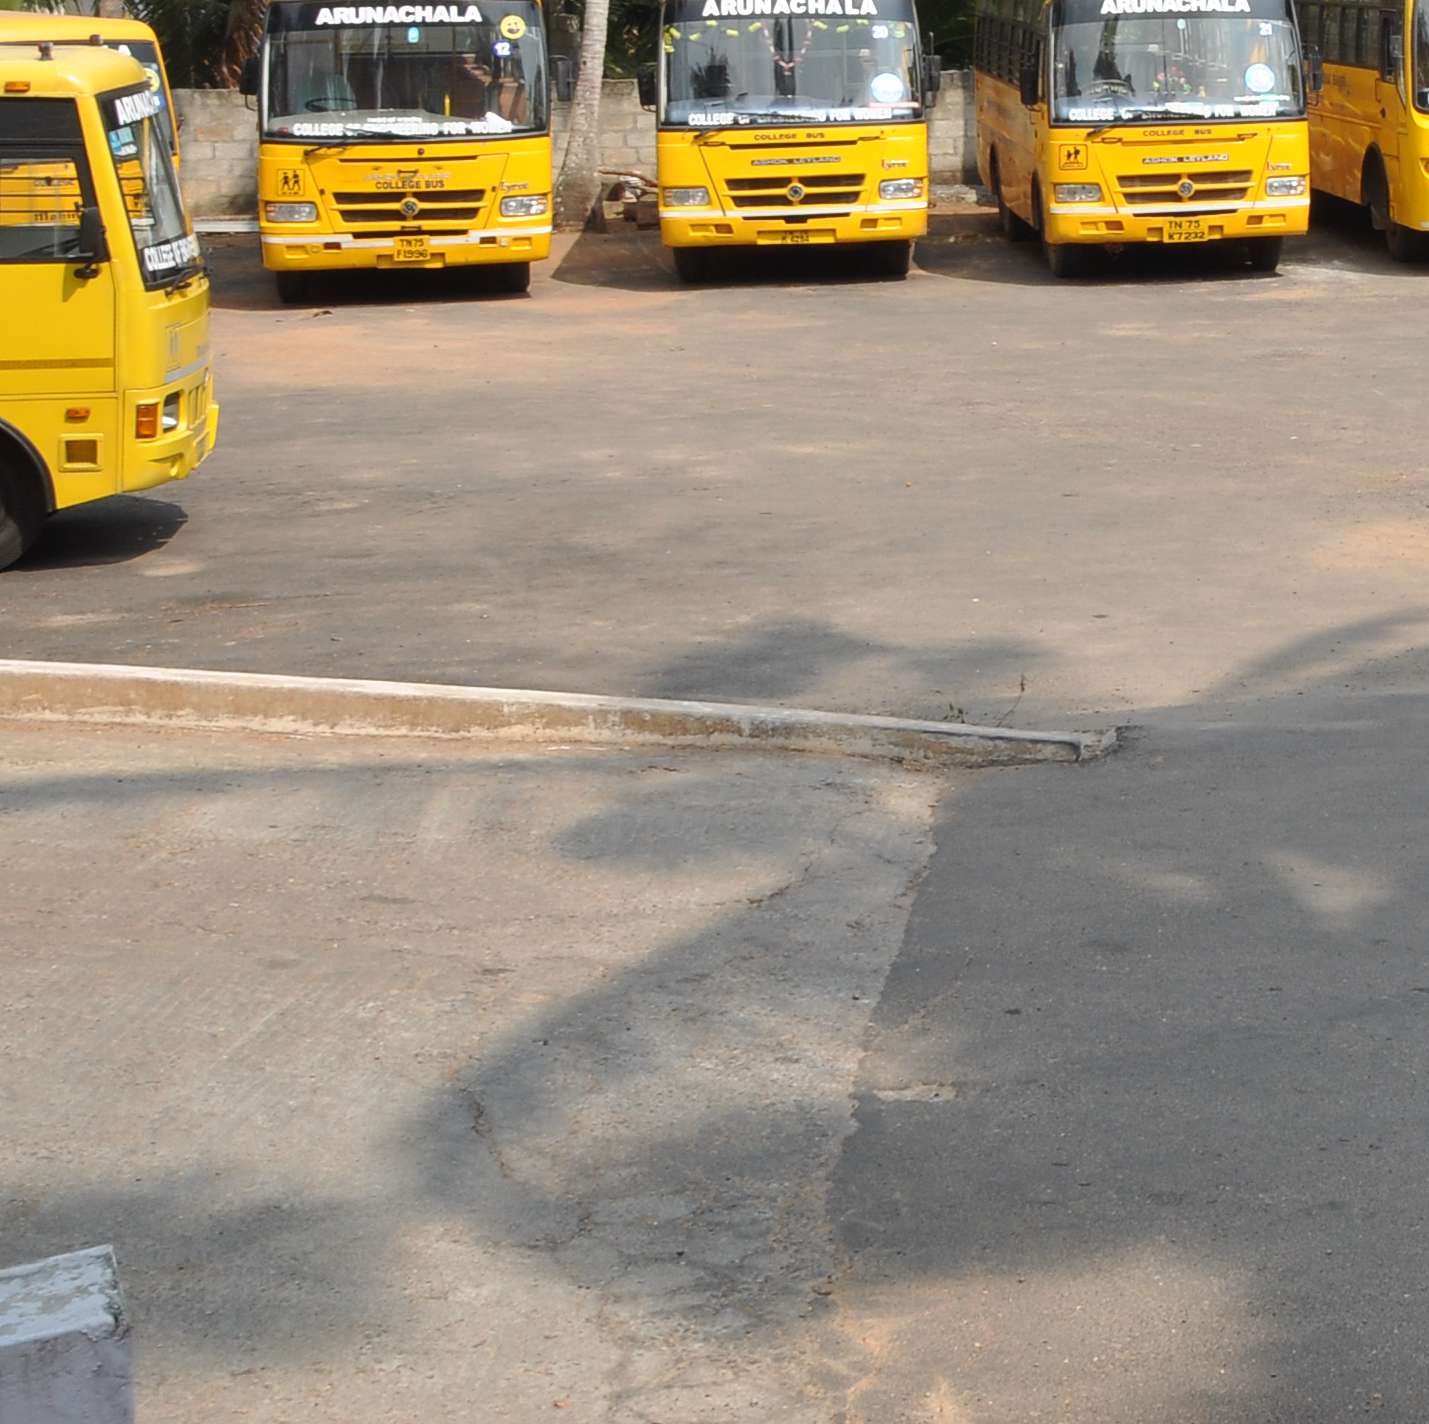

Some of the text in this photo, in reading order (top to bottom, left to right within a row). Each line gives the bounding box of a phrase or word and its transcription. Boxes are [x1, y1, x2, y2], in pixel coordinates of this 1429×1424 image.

[315, 5, 483, 25] ARUNACHALA
[494, 41, 511, 57] 12
[376, 179, 445, 190] COLLEGE BUS
[1168, 220, 1200, 230] TN 75
